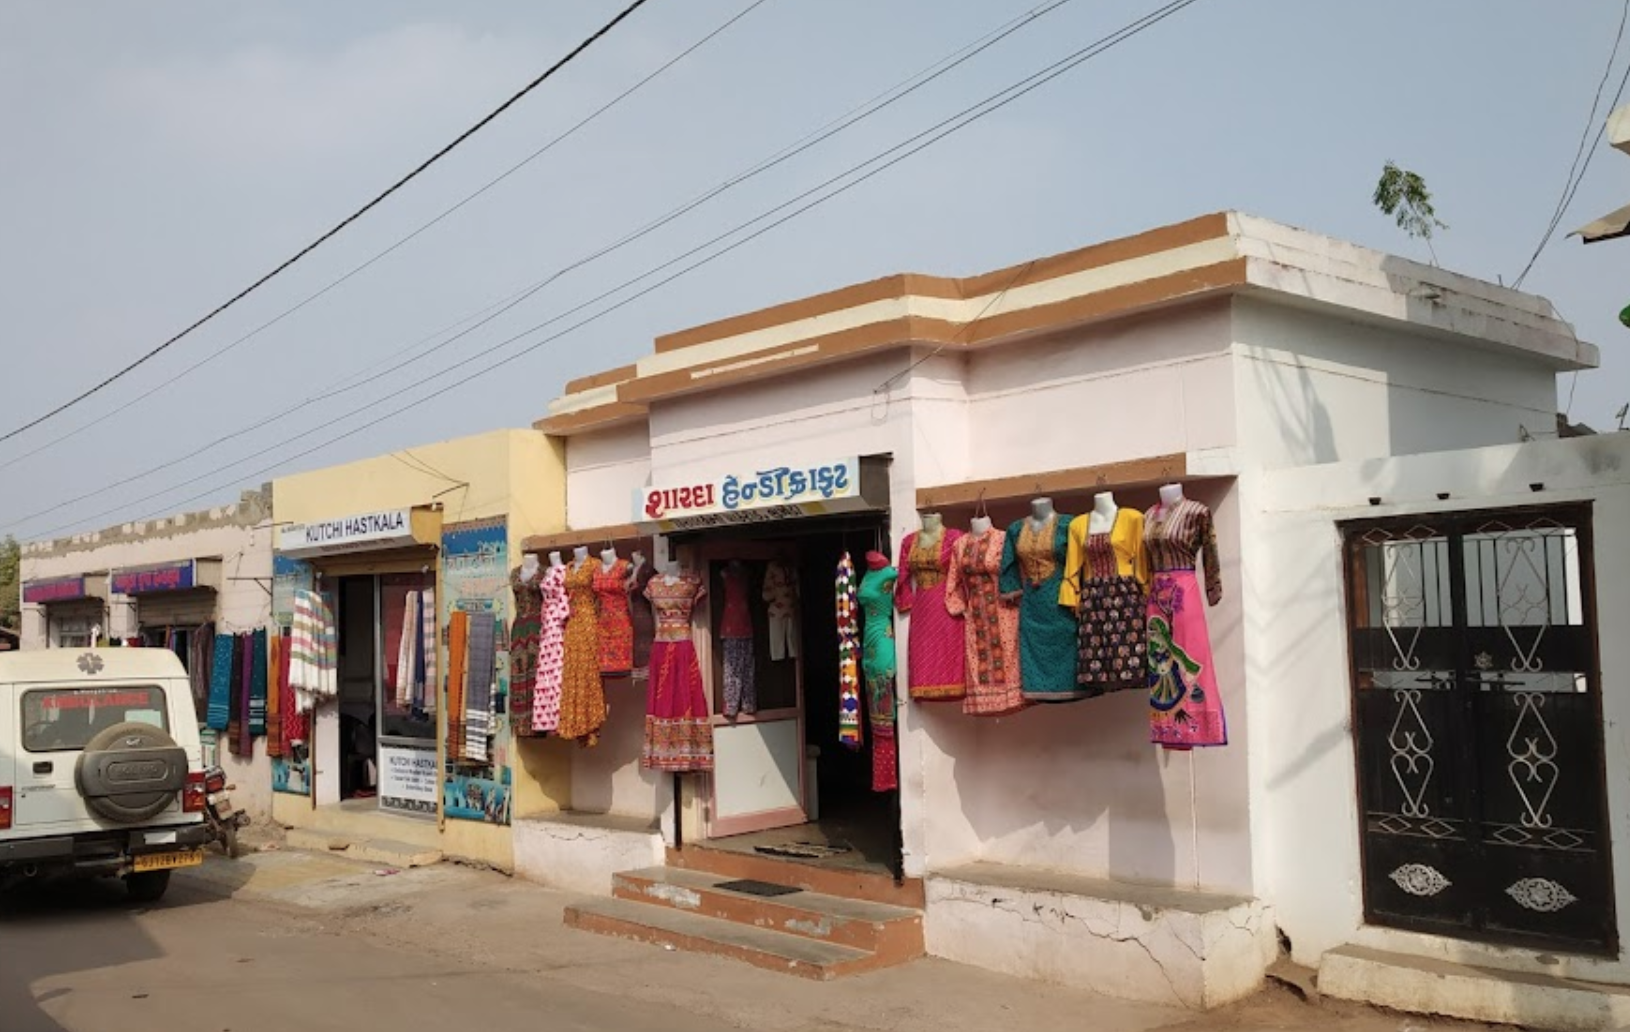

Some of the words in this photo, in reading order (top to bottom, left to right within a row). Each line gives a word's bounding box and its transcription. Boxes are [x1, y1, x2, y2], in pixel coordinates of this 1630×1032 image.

[646, 484, 714, 518] શારદા
[306, 519, 343, 542] KUTCHI
[346, 512, 404, 536] HASTKALA
[42, 692, 149, 709] AMBULANCE
